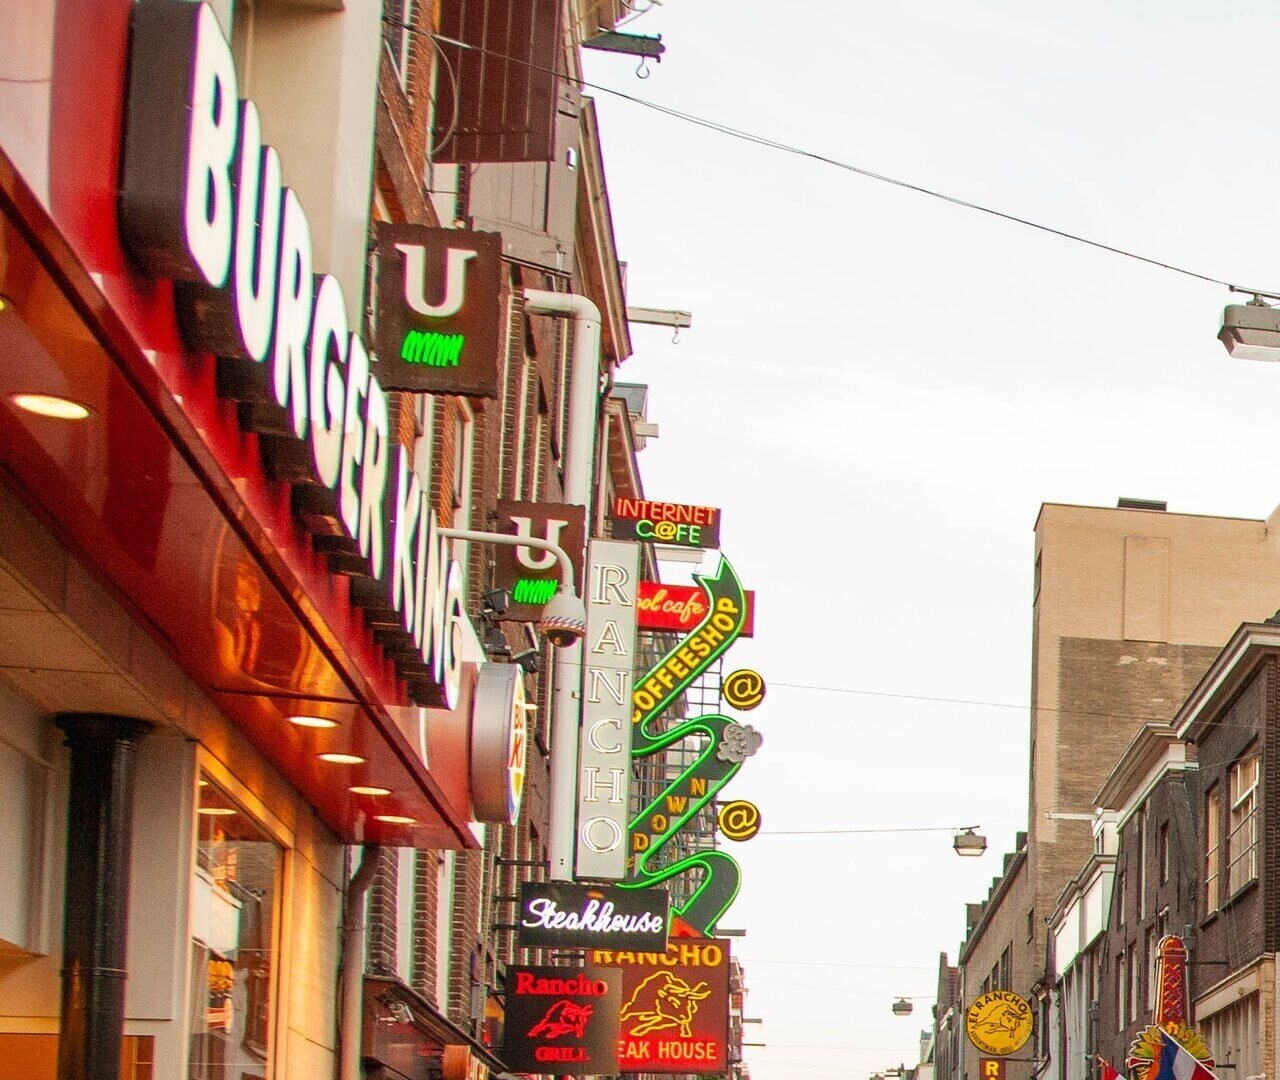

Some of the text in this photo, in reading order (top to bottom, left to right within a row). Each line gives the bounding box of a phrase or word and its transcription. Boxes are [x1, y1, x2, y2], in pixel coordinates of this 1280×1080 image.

[394, 243, 477, 318] U
[183, 0, 464, 711] BURGER KING
[616, 497, 717, 525] INTERNET
[636, 519, 701, 544] C@FE
[662, 590, 705, 623] cafe
[581, 563, 634, 854] RANCHO
[522, 897, 664, 935] Steakhouse
[592, 941, 722, 967] RANCHO
[516, 972, 609, 996] Rancho
[968, 992, 1028, 1024] EL RANCHO
[534, 1046, 590, 1062] GRILL
[619, 1041, 717, 1060] EAK HOUSE
